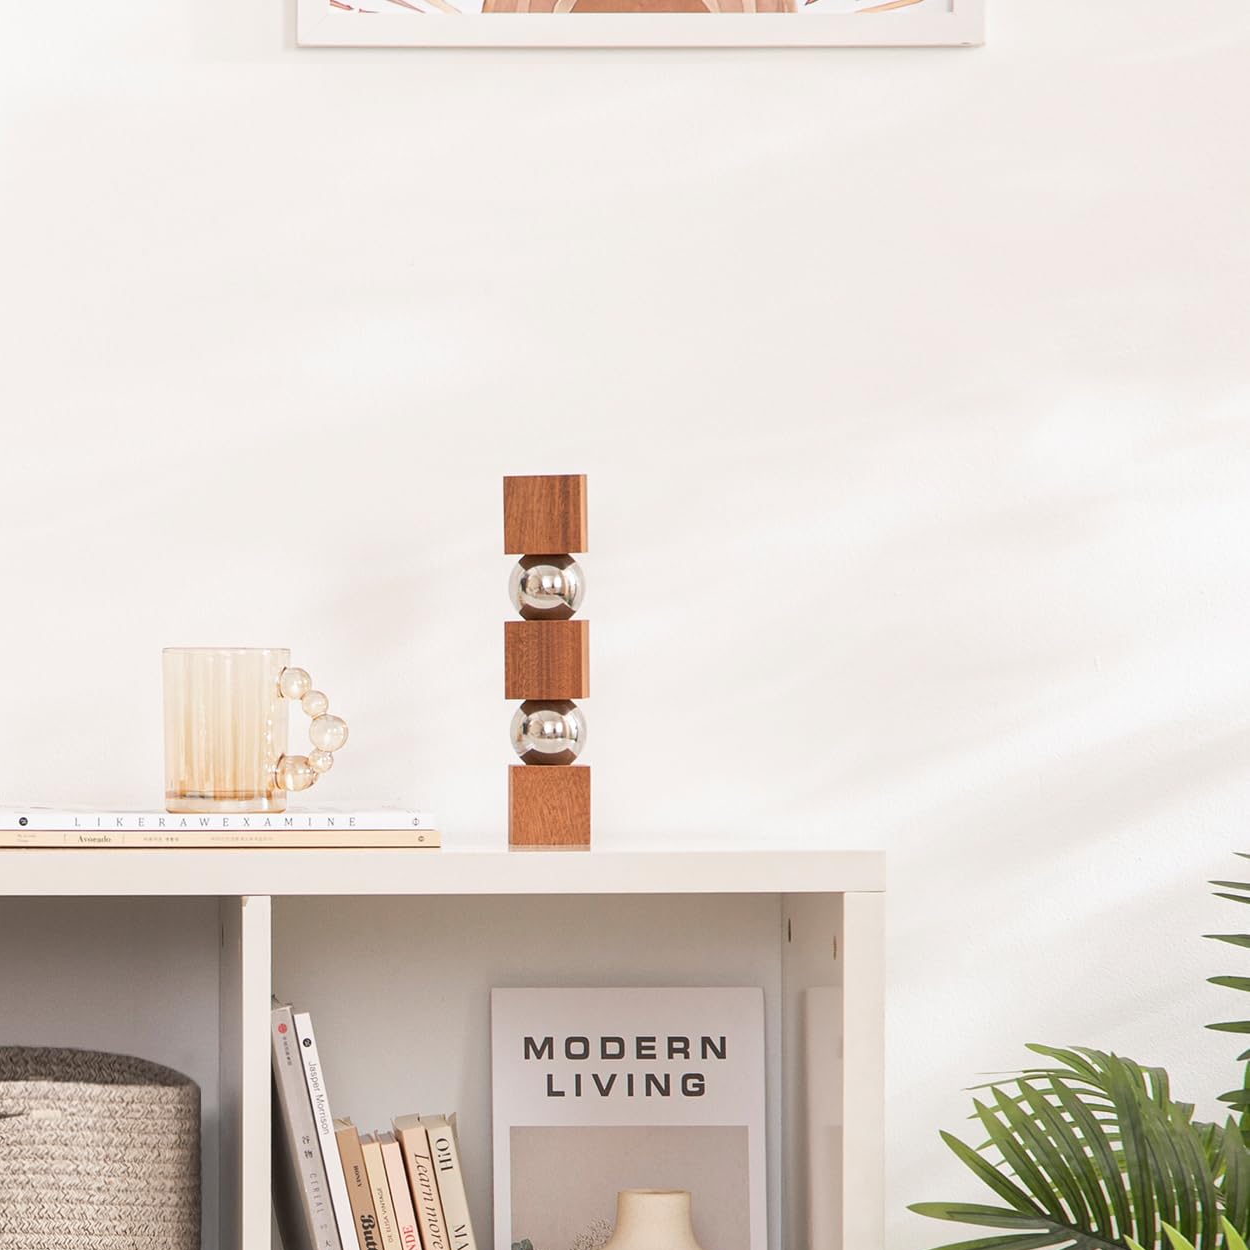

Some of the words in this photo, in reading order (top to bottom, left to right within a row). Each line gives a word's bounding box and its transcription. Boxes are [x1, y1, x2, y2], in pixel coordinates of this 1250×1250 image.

[523, 1036, 727, 1060] MODERN
[309, 1061, 321, 1092] Jasper
[316, 1094, 330, 1136] Morrison
[546, 1073, 707, 1097] LIVING
[436, 1137, 454, 1172] O!H
[309, 1172, 325, 1214] CEREAL
[377, 1187, 387, 1215] VINTAGE
[415, 1153, 433, 1204] Learn
[427, 1207, 443, 1248] more
